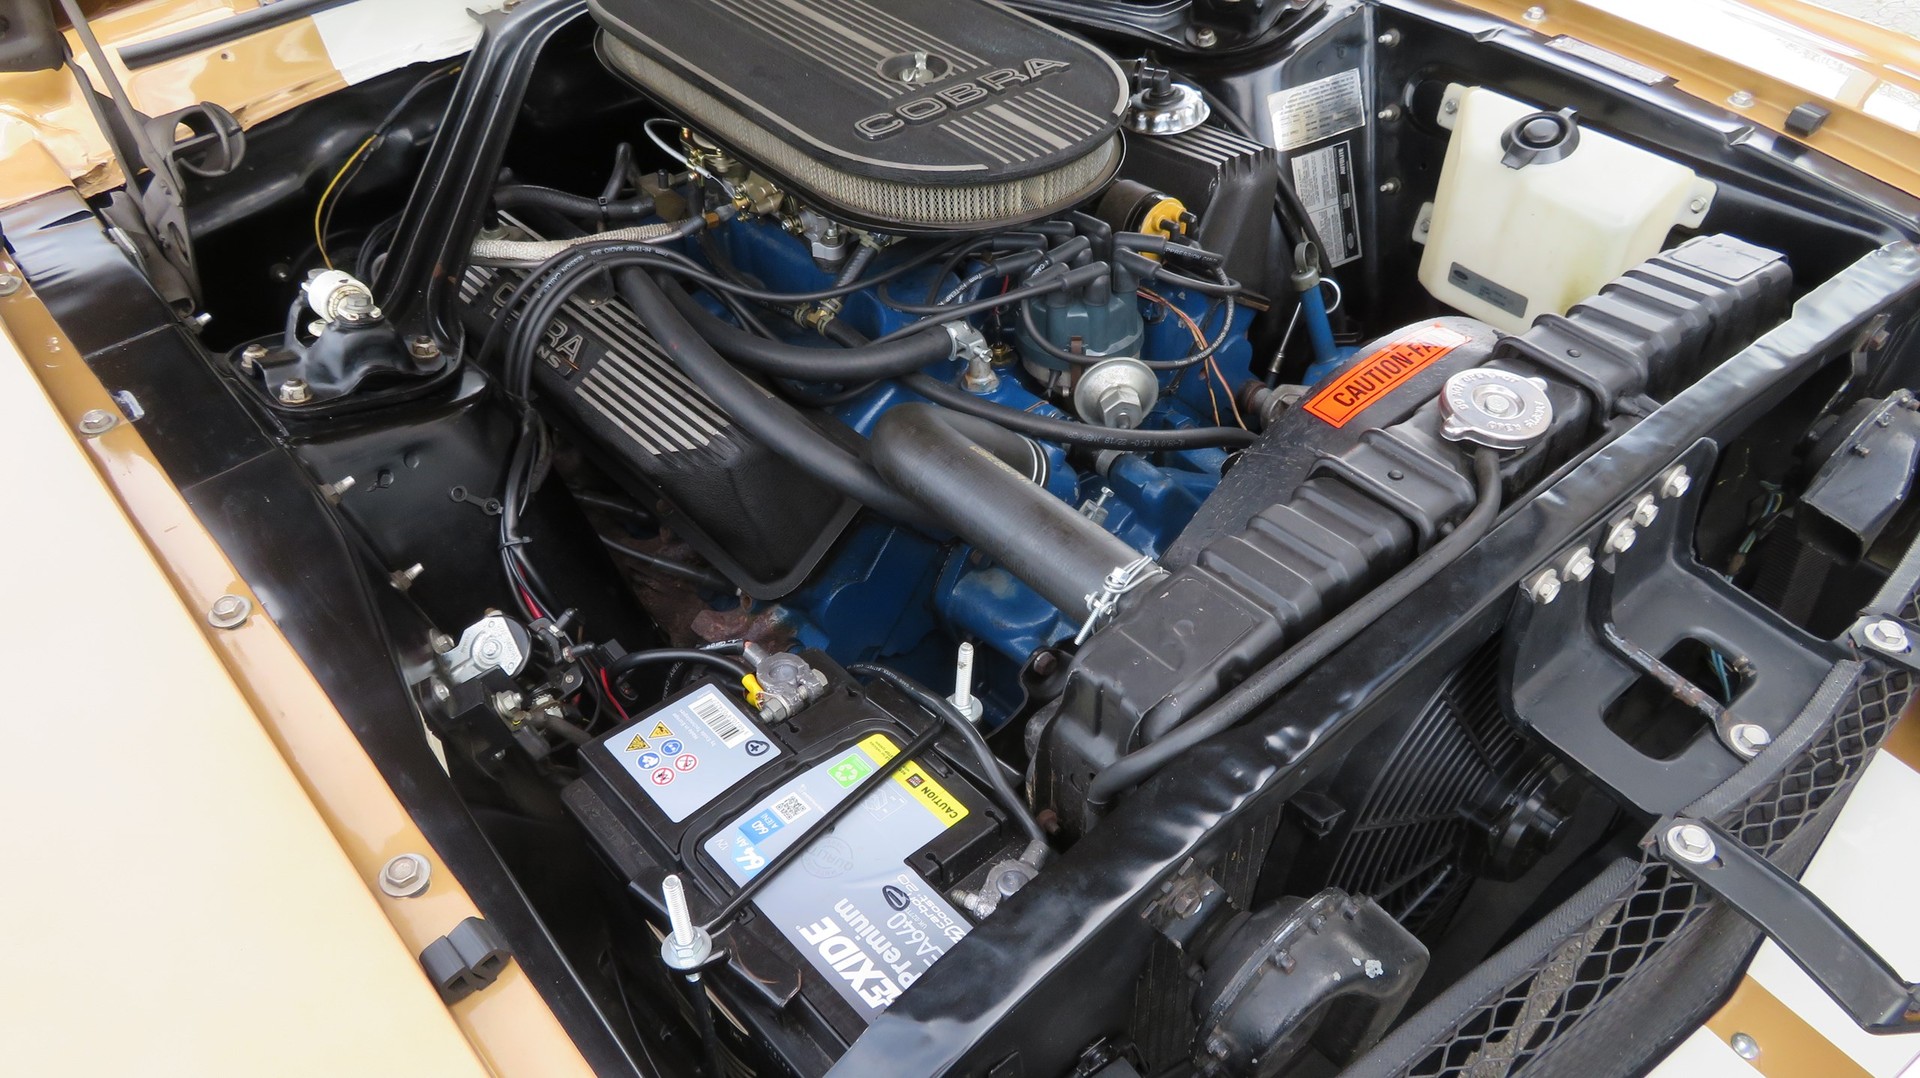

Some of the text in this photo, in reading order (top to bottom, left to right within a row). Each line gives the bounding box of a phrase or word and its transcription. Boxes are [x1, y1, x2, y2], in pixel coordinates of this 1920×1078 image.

[853, 57, 1071, 145] COBRA
[1332, 339, 1437, 407] CAUTION-FA
[750, 819, 769, 835] 640
[920, 785, 958, 818] CAUTION
[734, 835, 766, 871] 64 Ah
[798, 914, 902, 1009] EXIDE
[832, 896, 922, 989] Premium
[885, 909, 944, 967] EA640
